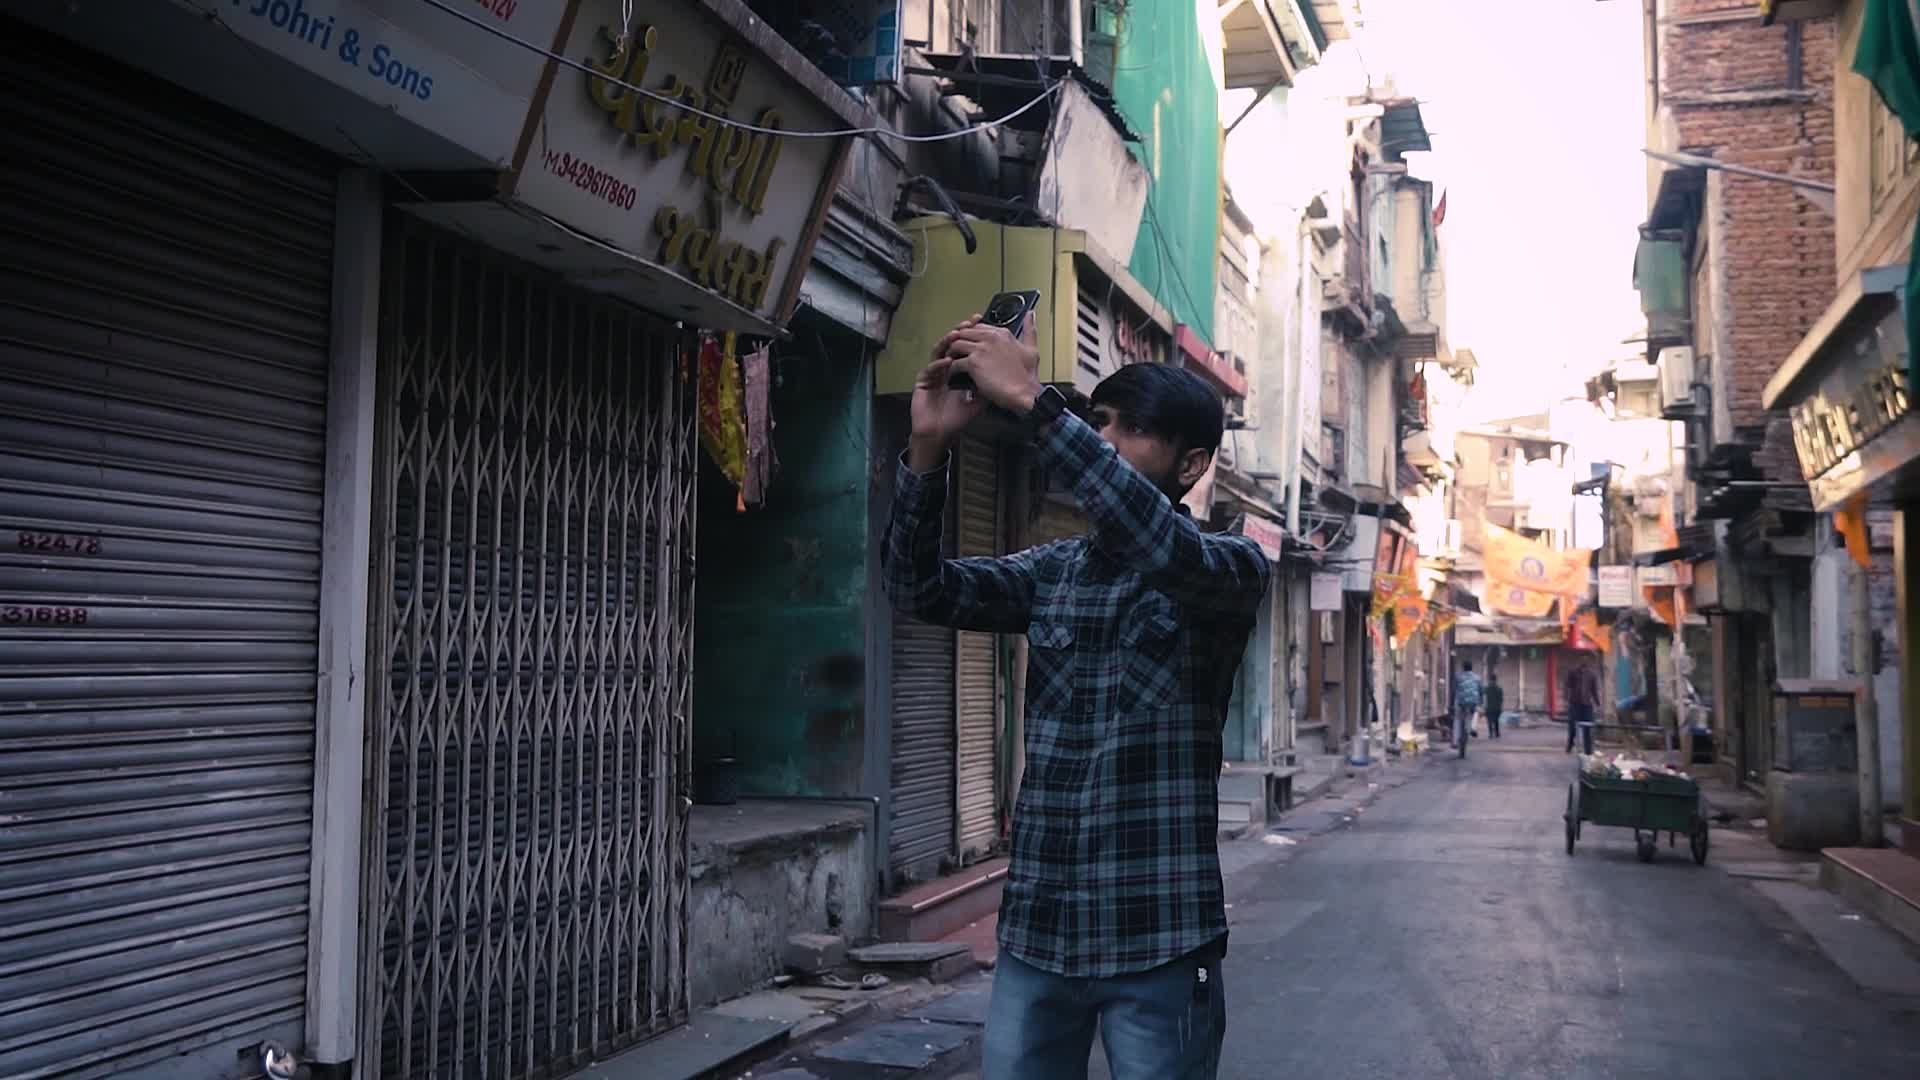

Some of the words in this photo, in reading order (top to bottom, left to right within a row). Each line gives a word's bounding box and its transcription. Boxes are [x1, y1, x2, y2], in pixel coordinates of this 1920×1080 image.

[250, 0, 334, 50] Johri
[338, 28, 360, 66] &
[367, 44, 433, 100] Sons
[2, 605, 87, 624] 31688
